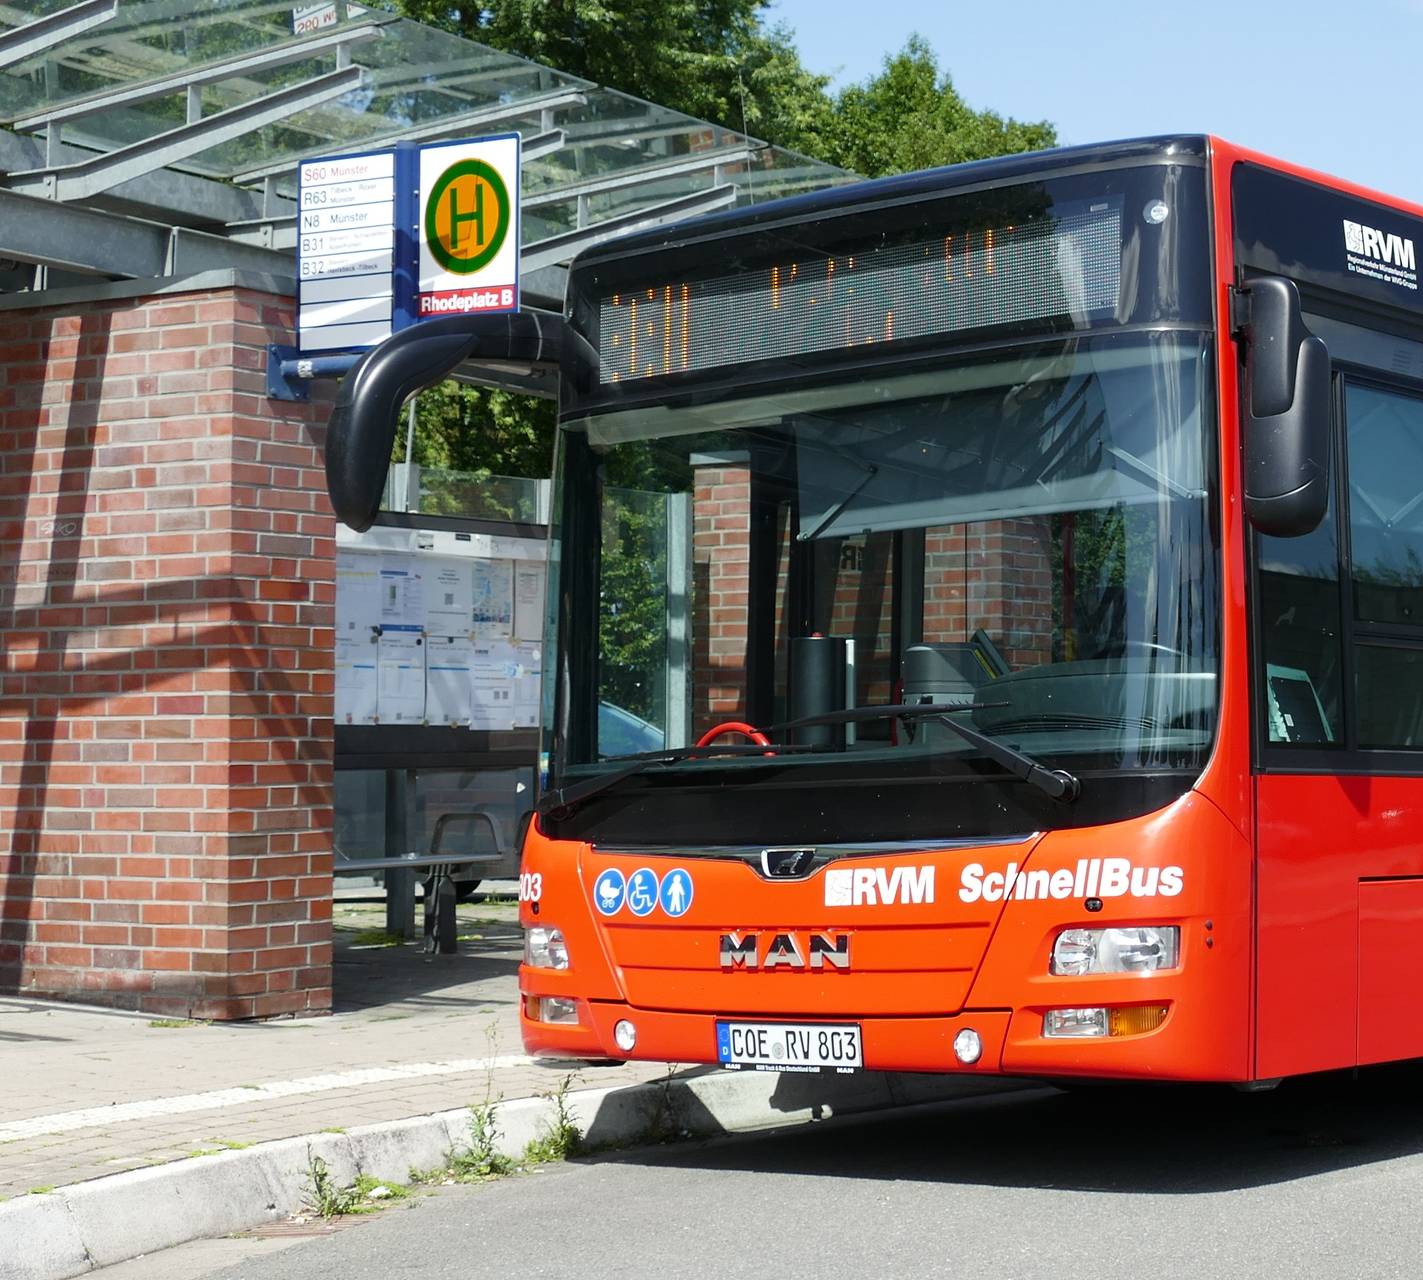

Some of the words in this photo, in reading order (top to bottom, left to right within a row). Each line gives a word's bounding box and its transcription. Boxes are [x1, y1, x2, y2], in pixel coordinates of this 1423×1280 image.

[304, 167, 327, 182] S60
[304, 190, 327, 205] R63
[304, 215, 320, 229] N8
[450, 183, 484, 250] H
[302, 238, 323, 252] B31
[1361, 225, 1416, 270] RVM
[302, 261, 323, 276] B32
[421, 292, 499, 312] Rhodeplatz
[501, 289, 513, 306] B
[853, 866, 935, 904] RVM
[958, 858, 1184, 903] SchnellBus
[719, 932, 850, 968] MAN
[722, 1046, 729, 1056] D
[732, 1028, 770, 1058] COE
[785, 1030, 811, 1060] RV
[818, 1031, 857, 1061] 803
